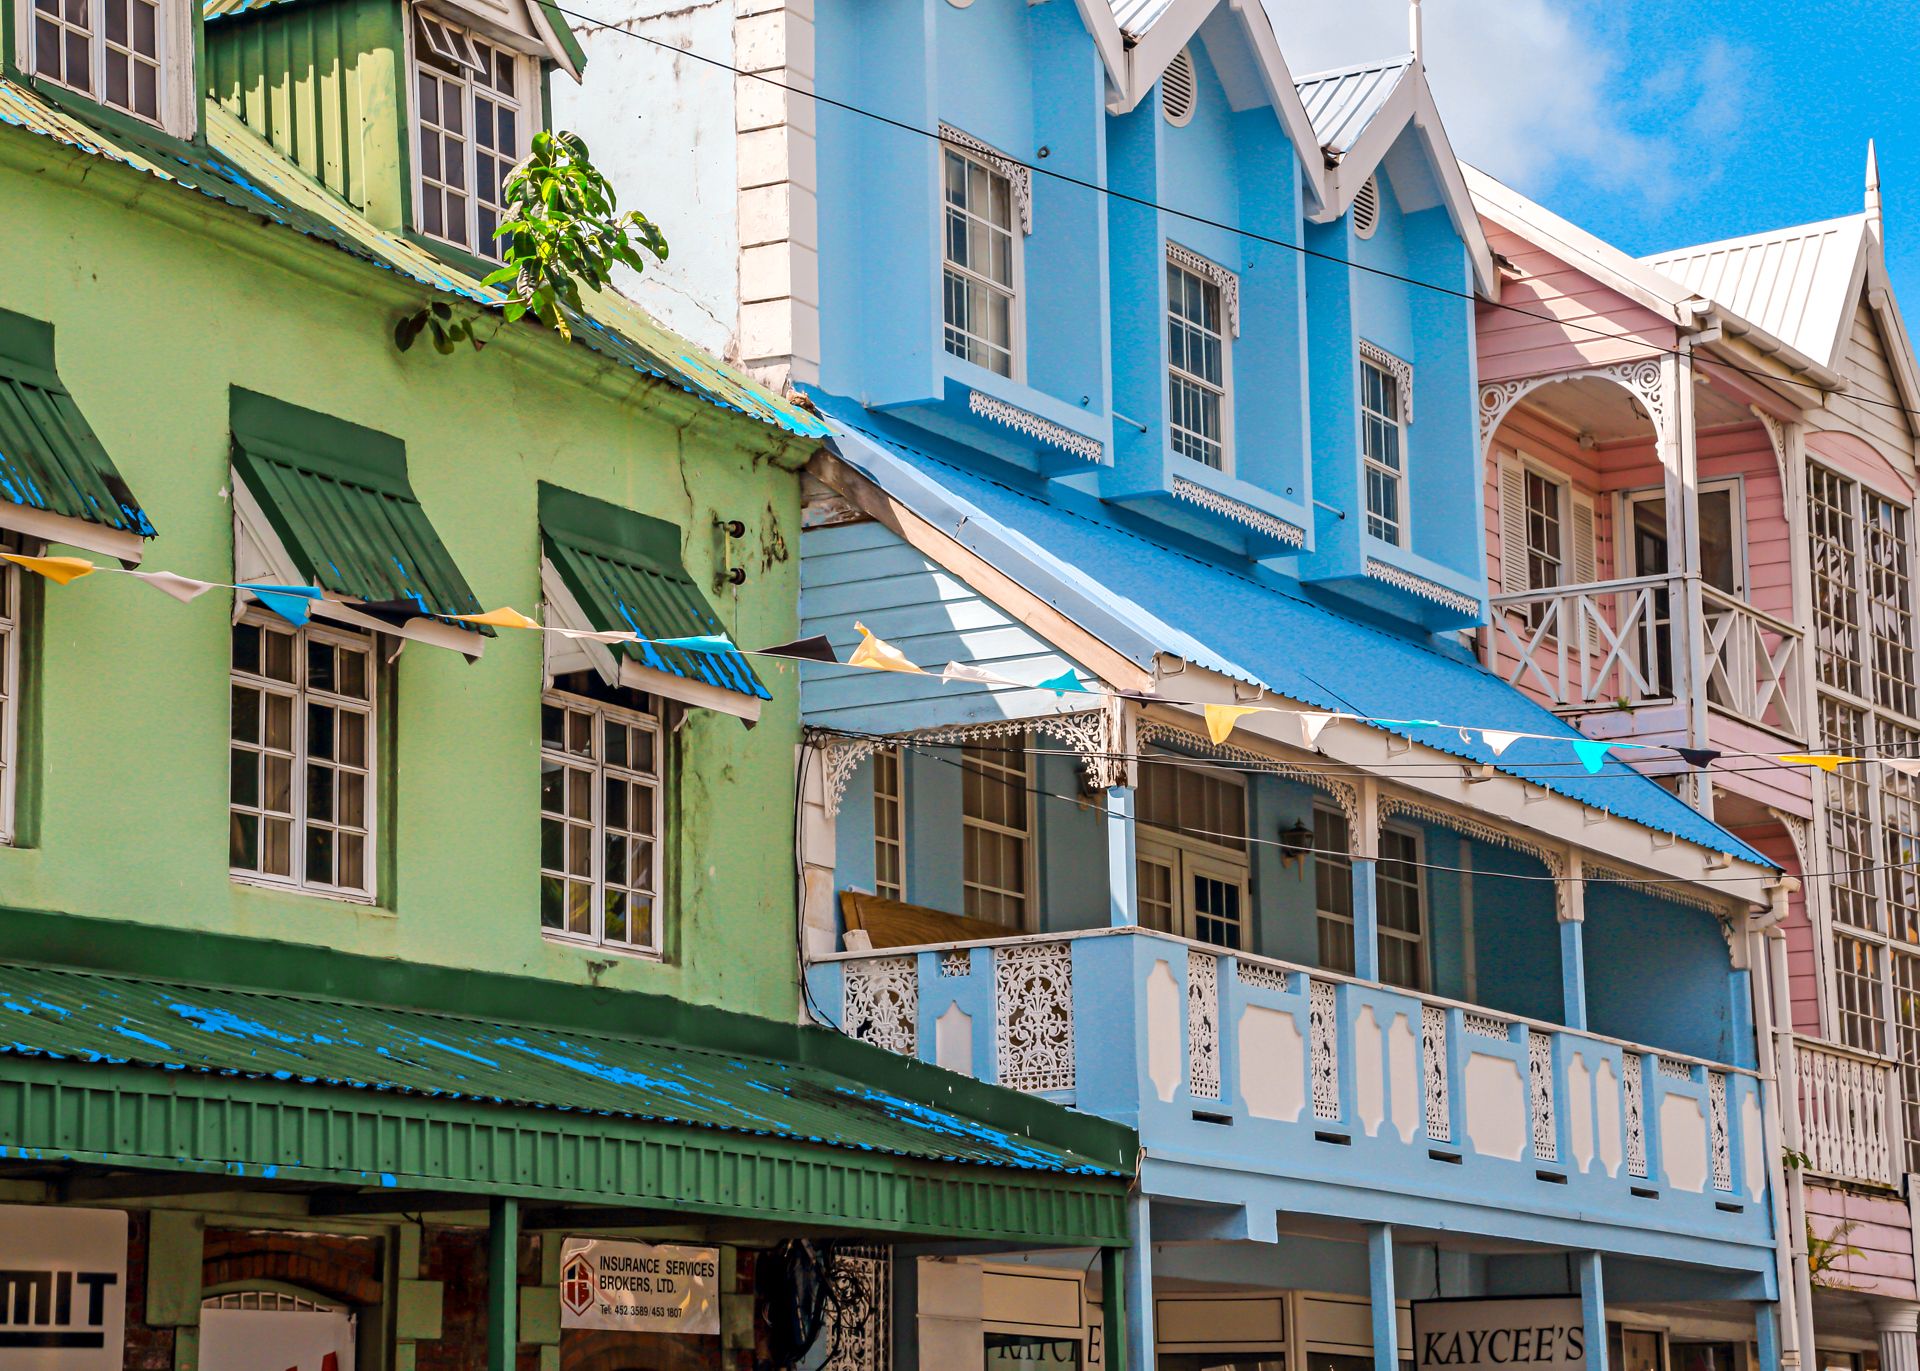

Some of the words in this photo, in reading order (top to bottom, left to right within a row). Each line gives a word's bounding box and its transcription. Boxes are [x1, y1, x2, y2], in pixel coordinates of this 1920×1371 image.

[600, 1255, 660, 1273] INSURANCE
[665, 1260, 715, 1277] SERVICES
[600, 1275, 653, 1295] BROKERS,
[656, 1280, 677, 1294] LTD.
[614, 1304, 628, 1316] 452
[666, 1307, 683, 1318] 1807
[1422, 1324, 1584, 1365] KAYCEE'S
